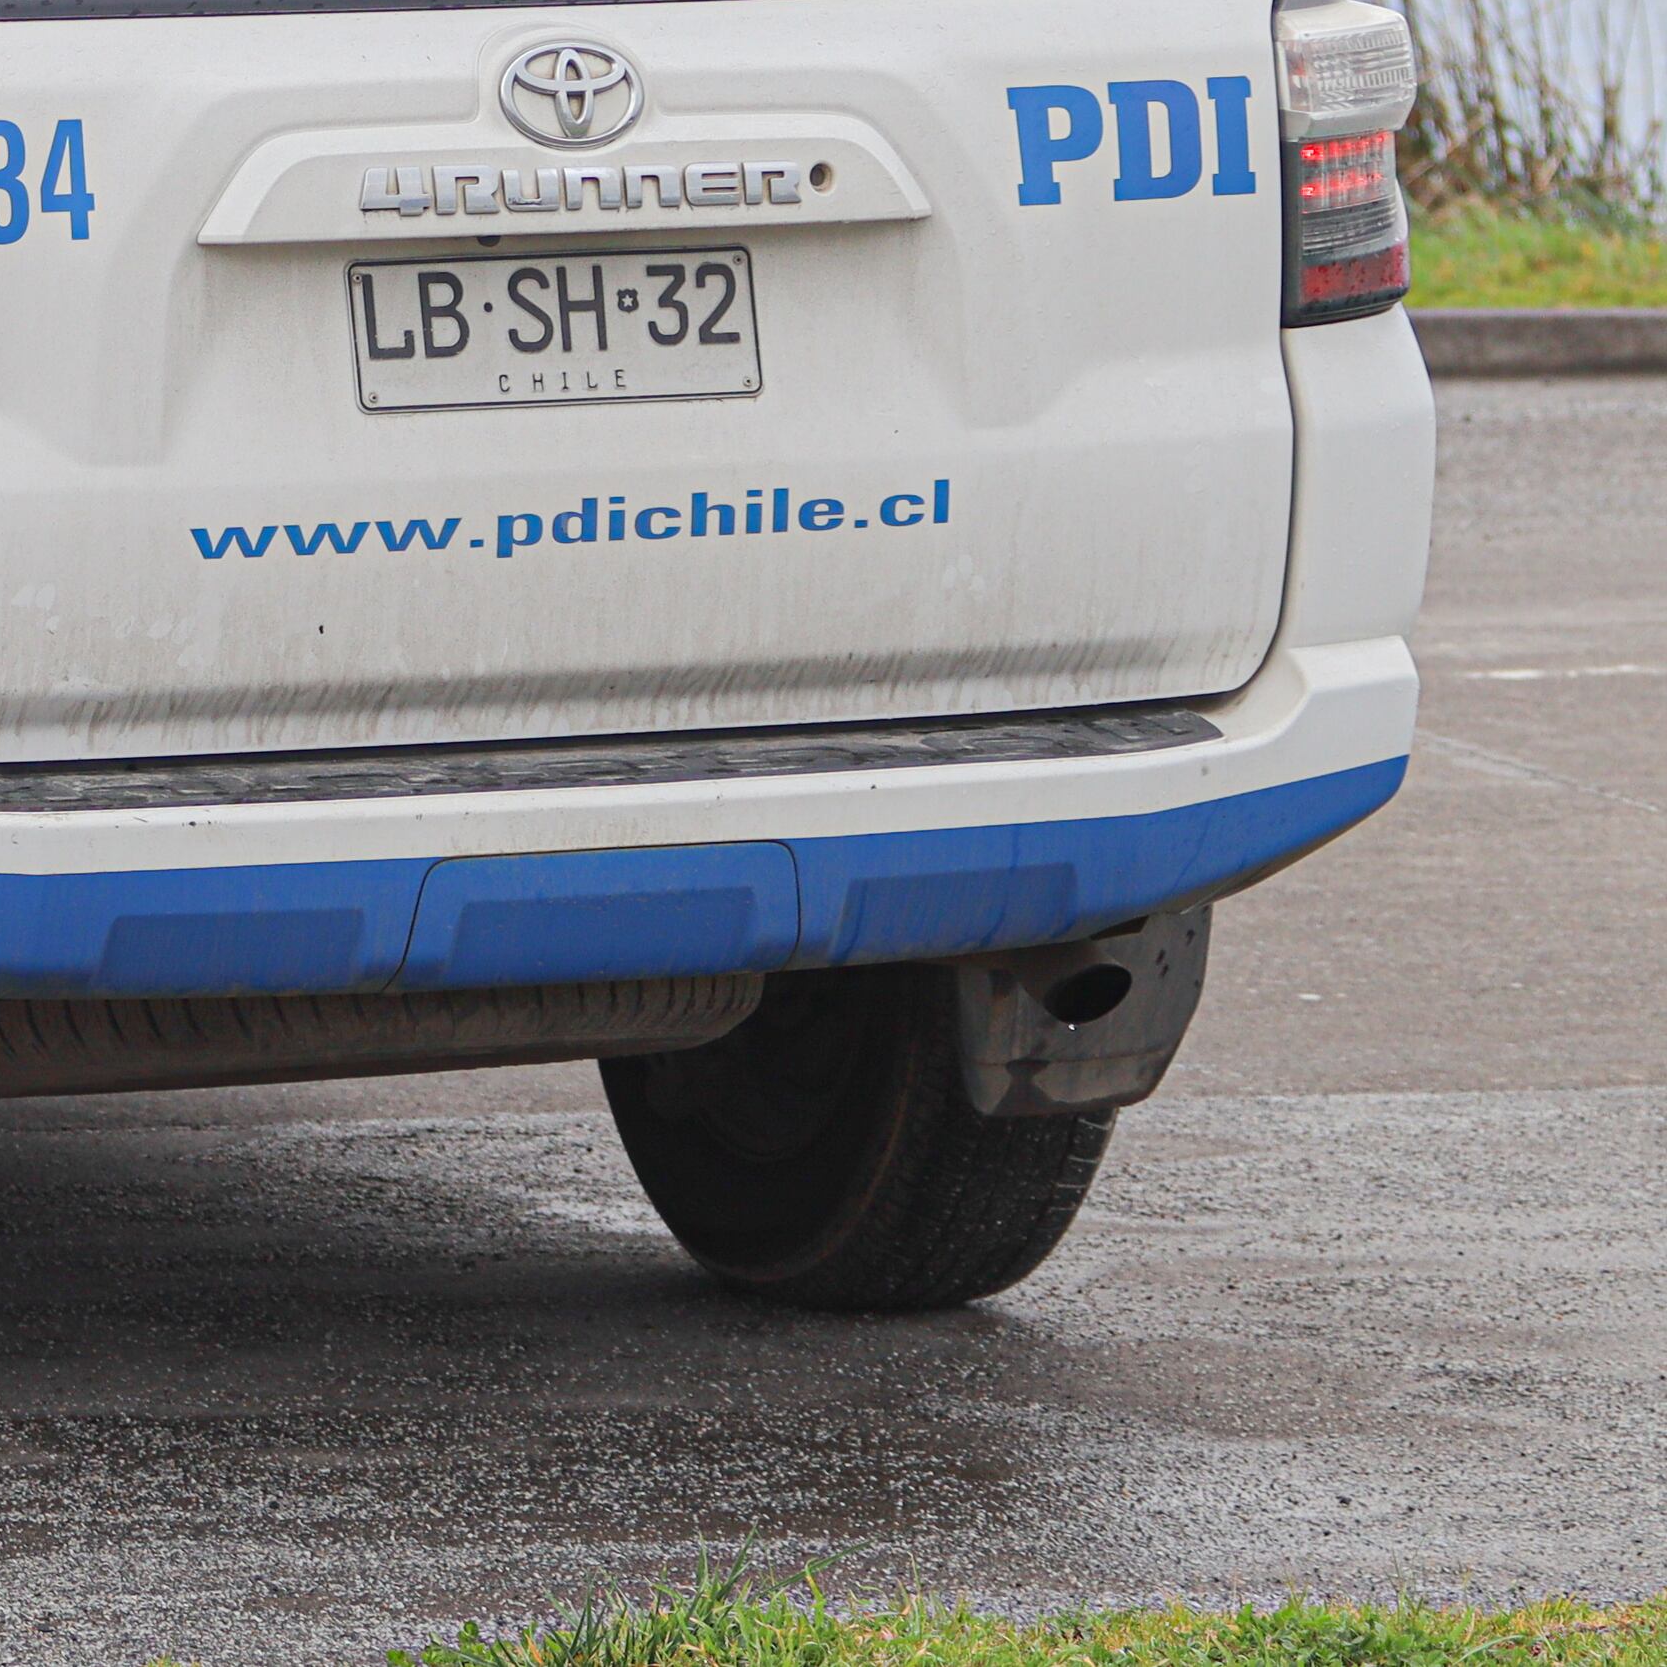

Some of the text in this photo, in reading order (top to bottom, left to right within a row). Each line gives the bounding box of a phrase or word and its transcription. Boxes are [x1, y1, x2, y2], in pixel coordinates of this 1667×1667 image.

[1006, 75, 1257, 206] PDI
[498, 368, 627, 394] CHILE
[189, 478, 951, 560] www.pdichile.cl
